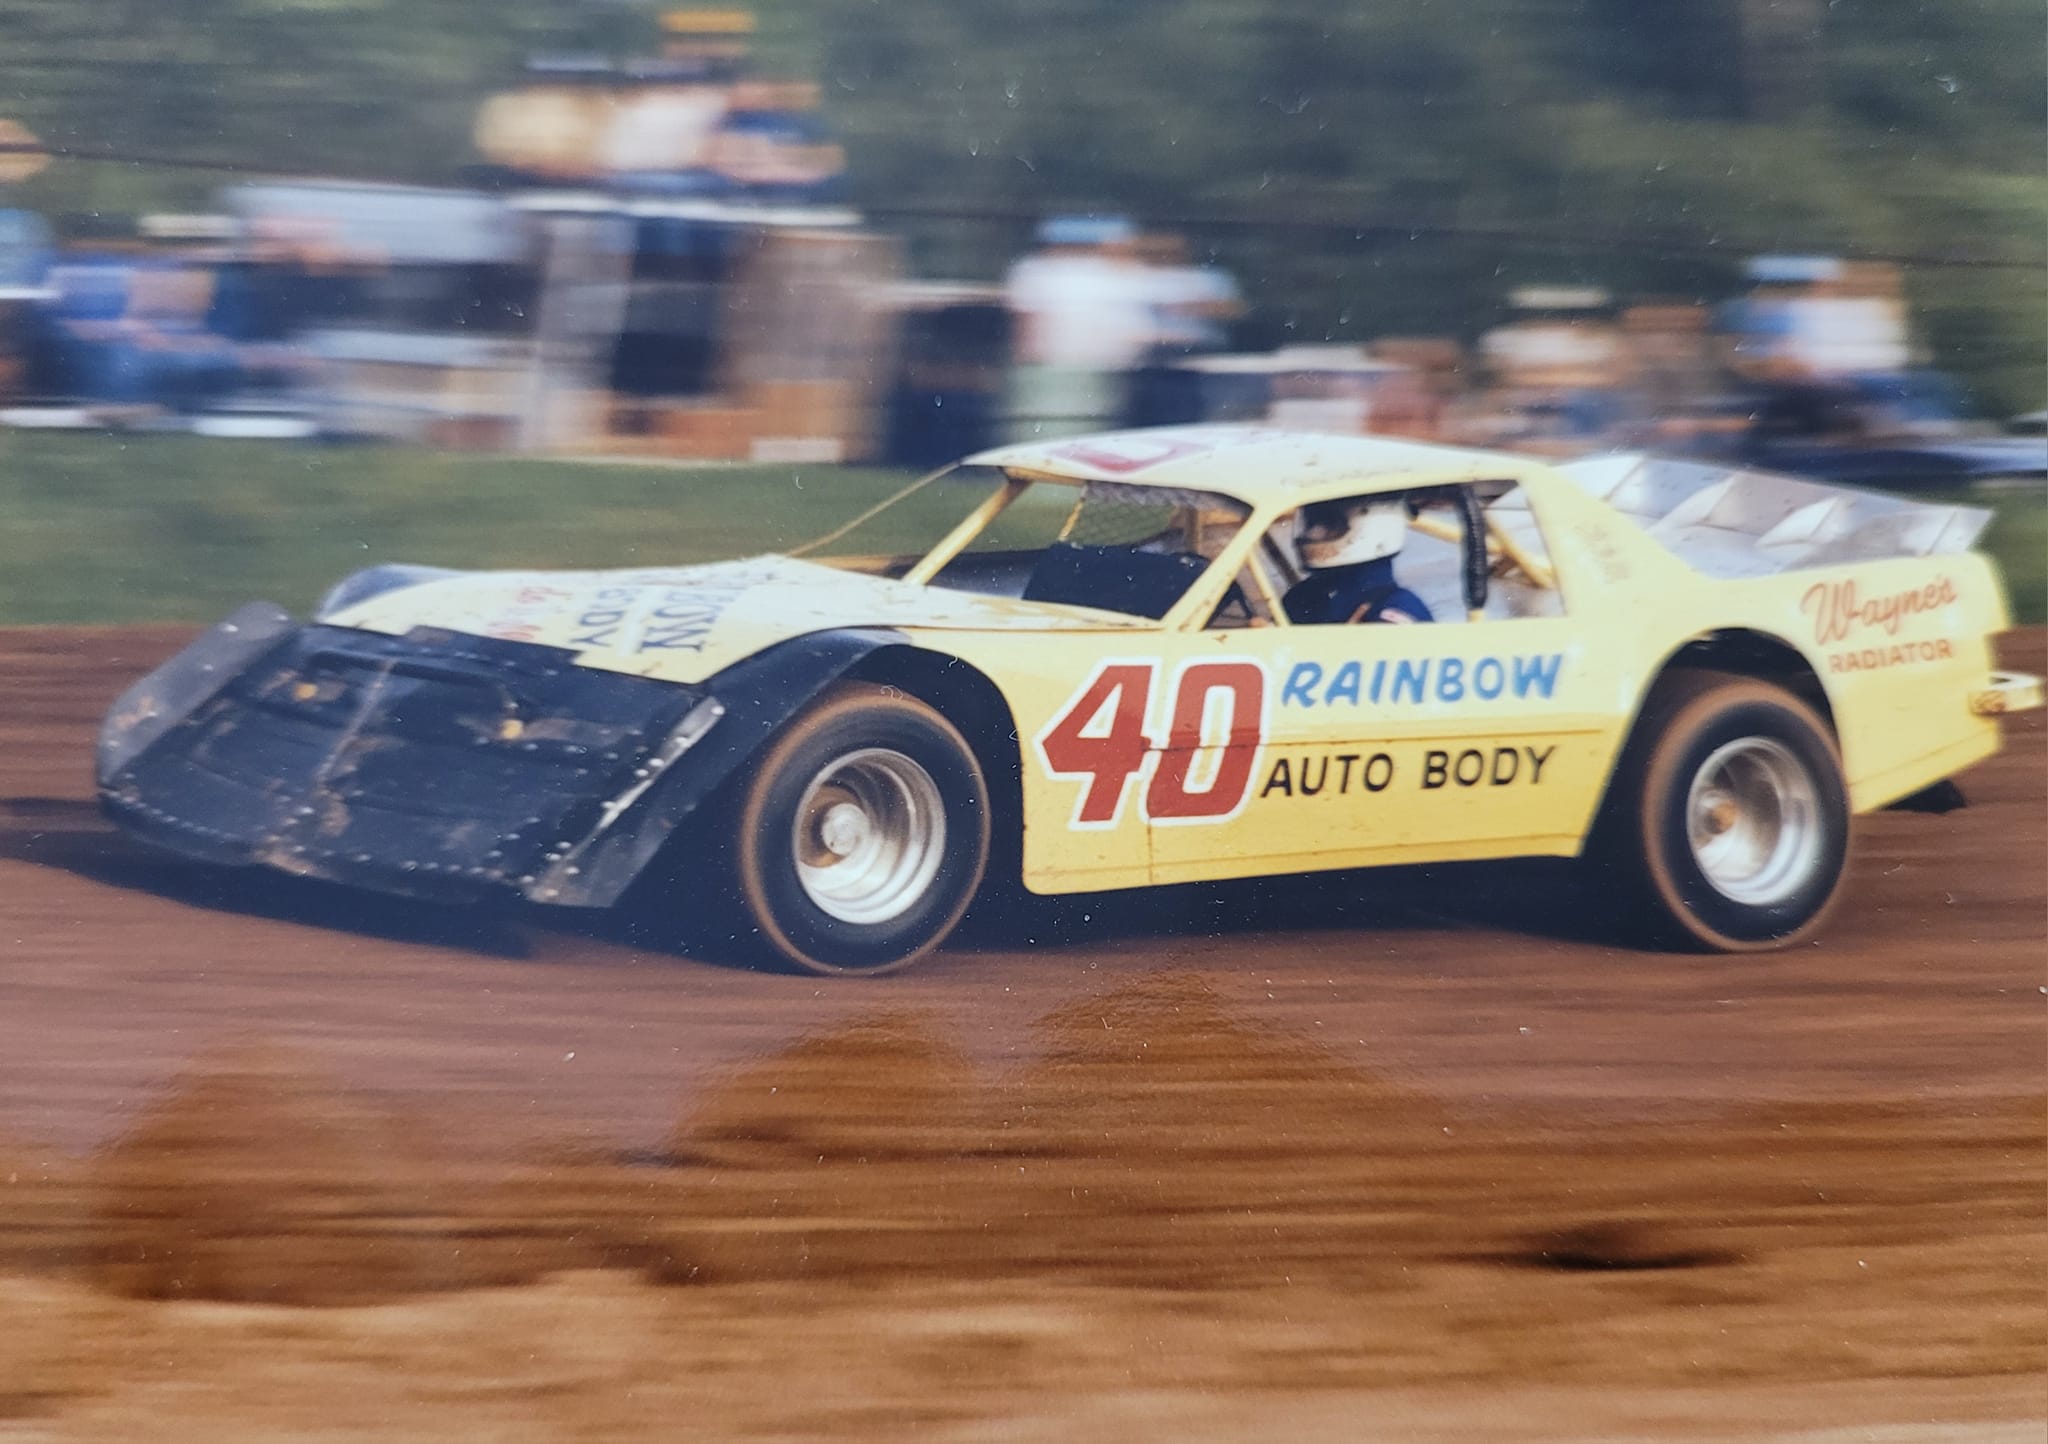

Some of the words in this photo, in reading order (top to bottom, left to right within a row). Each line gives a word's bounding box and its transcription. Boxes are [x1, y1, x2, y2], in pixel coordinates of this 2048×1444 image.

[1281, 653, 1563, 708] RAINBOW
[1829, 638, 1954, 673] RADIATOR
[1032, 656, 1272, 832] 40
[1260, 751, 1394, 799] AUTO
[1420, 745, 1558, 791] BODY
